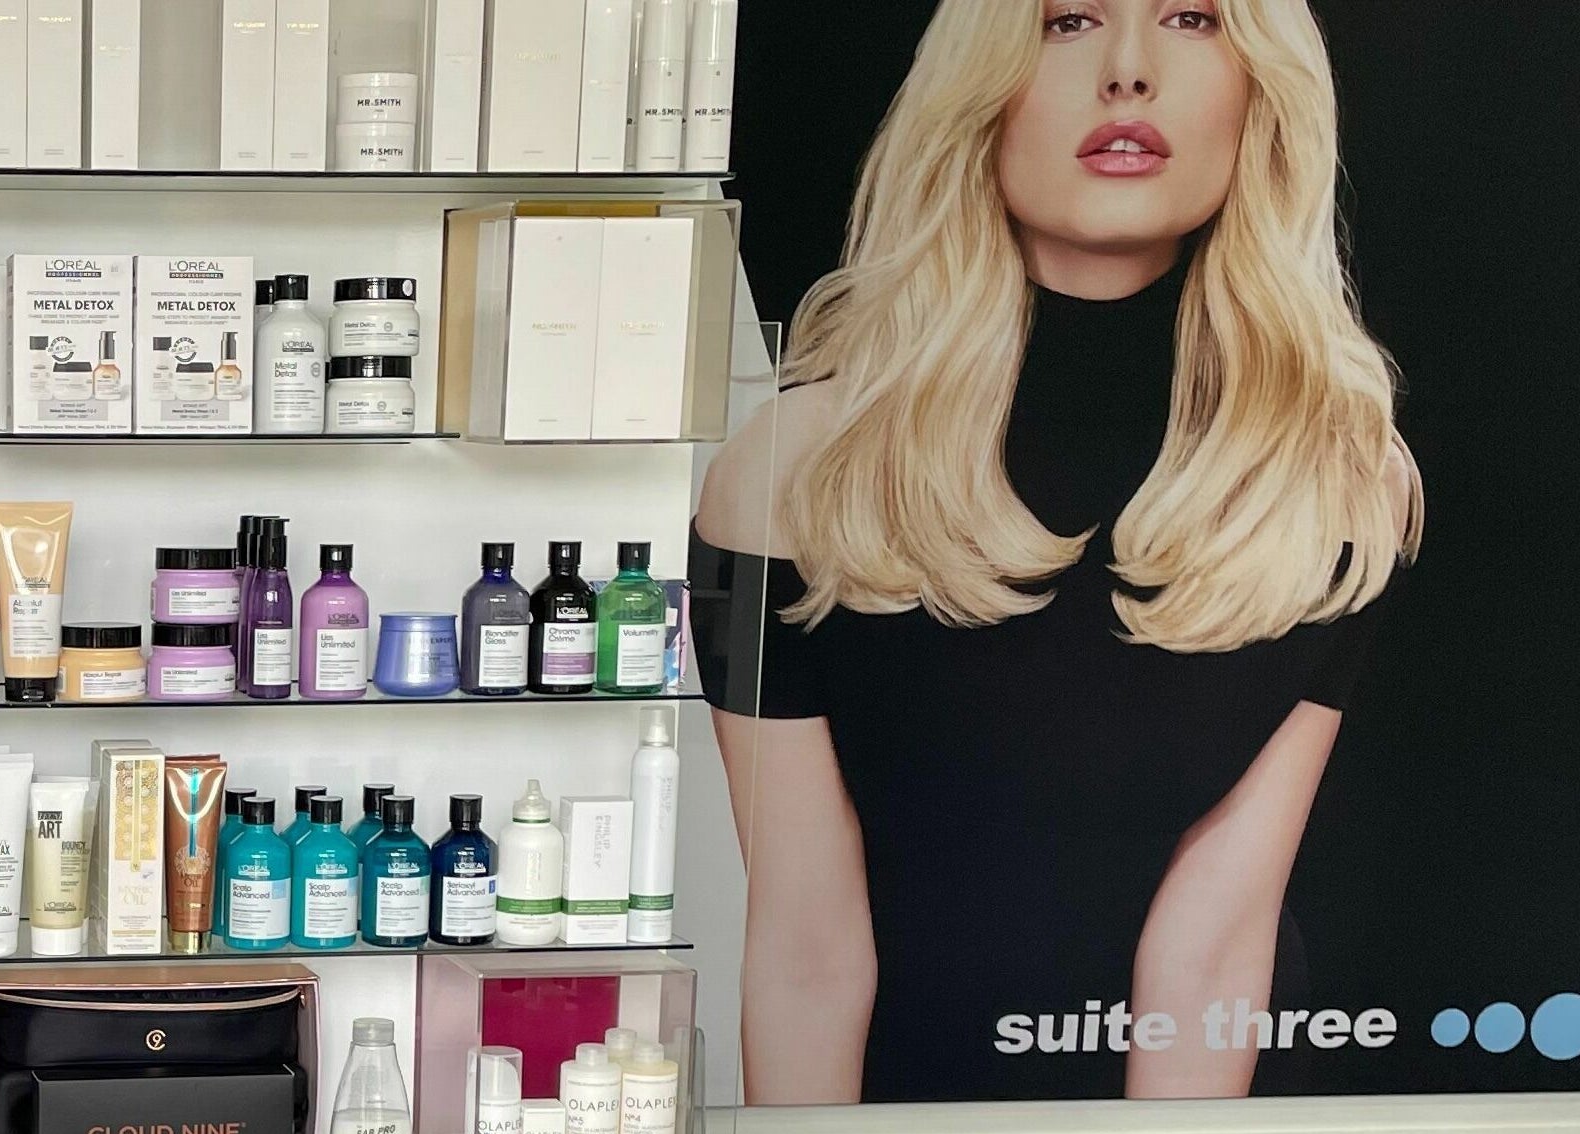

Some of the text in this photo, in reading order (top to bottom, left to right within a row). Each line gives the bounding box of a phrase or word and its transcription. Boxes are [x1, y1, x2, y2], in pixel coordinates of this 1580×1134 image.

[33, 300, 114, 311] METAL DETOX
[157, 301, 236, 311] METAL DETOX
[993, 999, 1398, 1054] suite three
